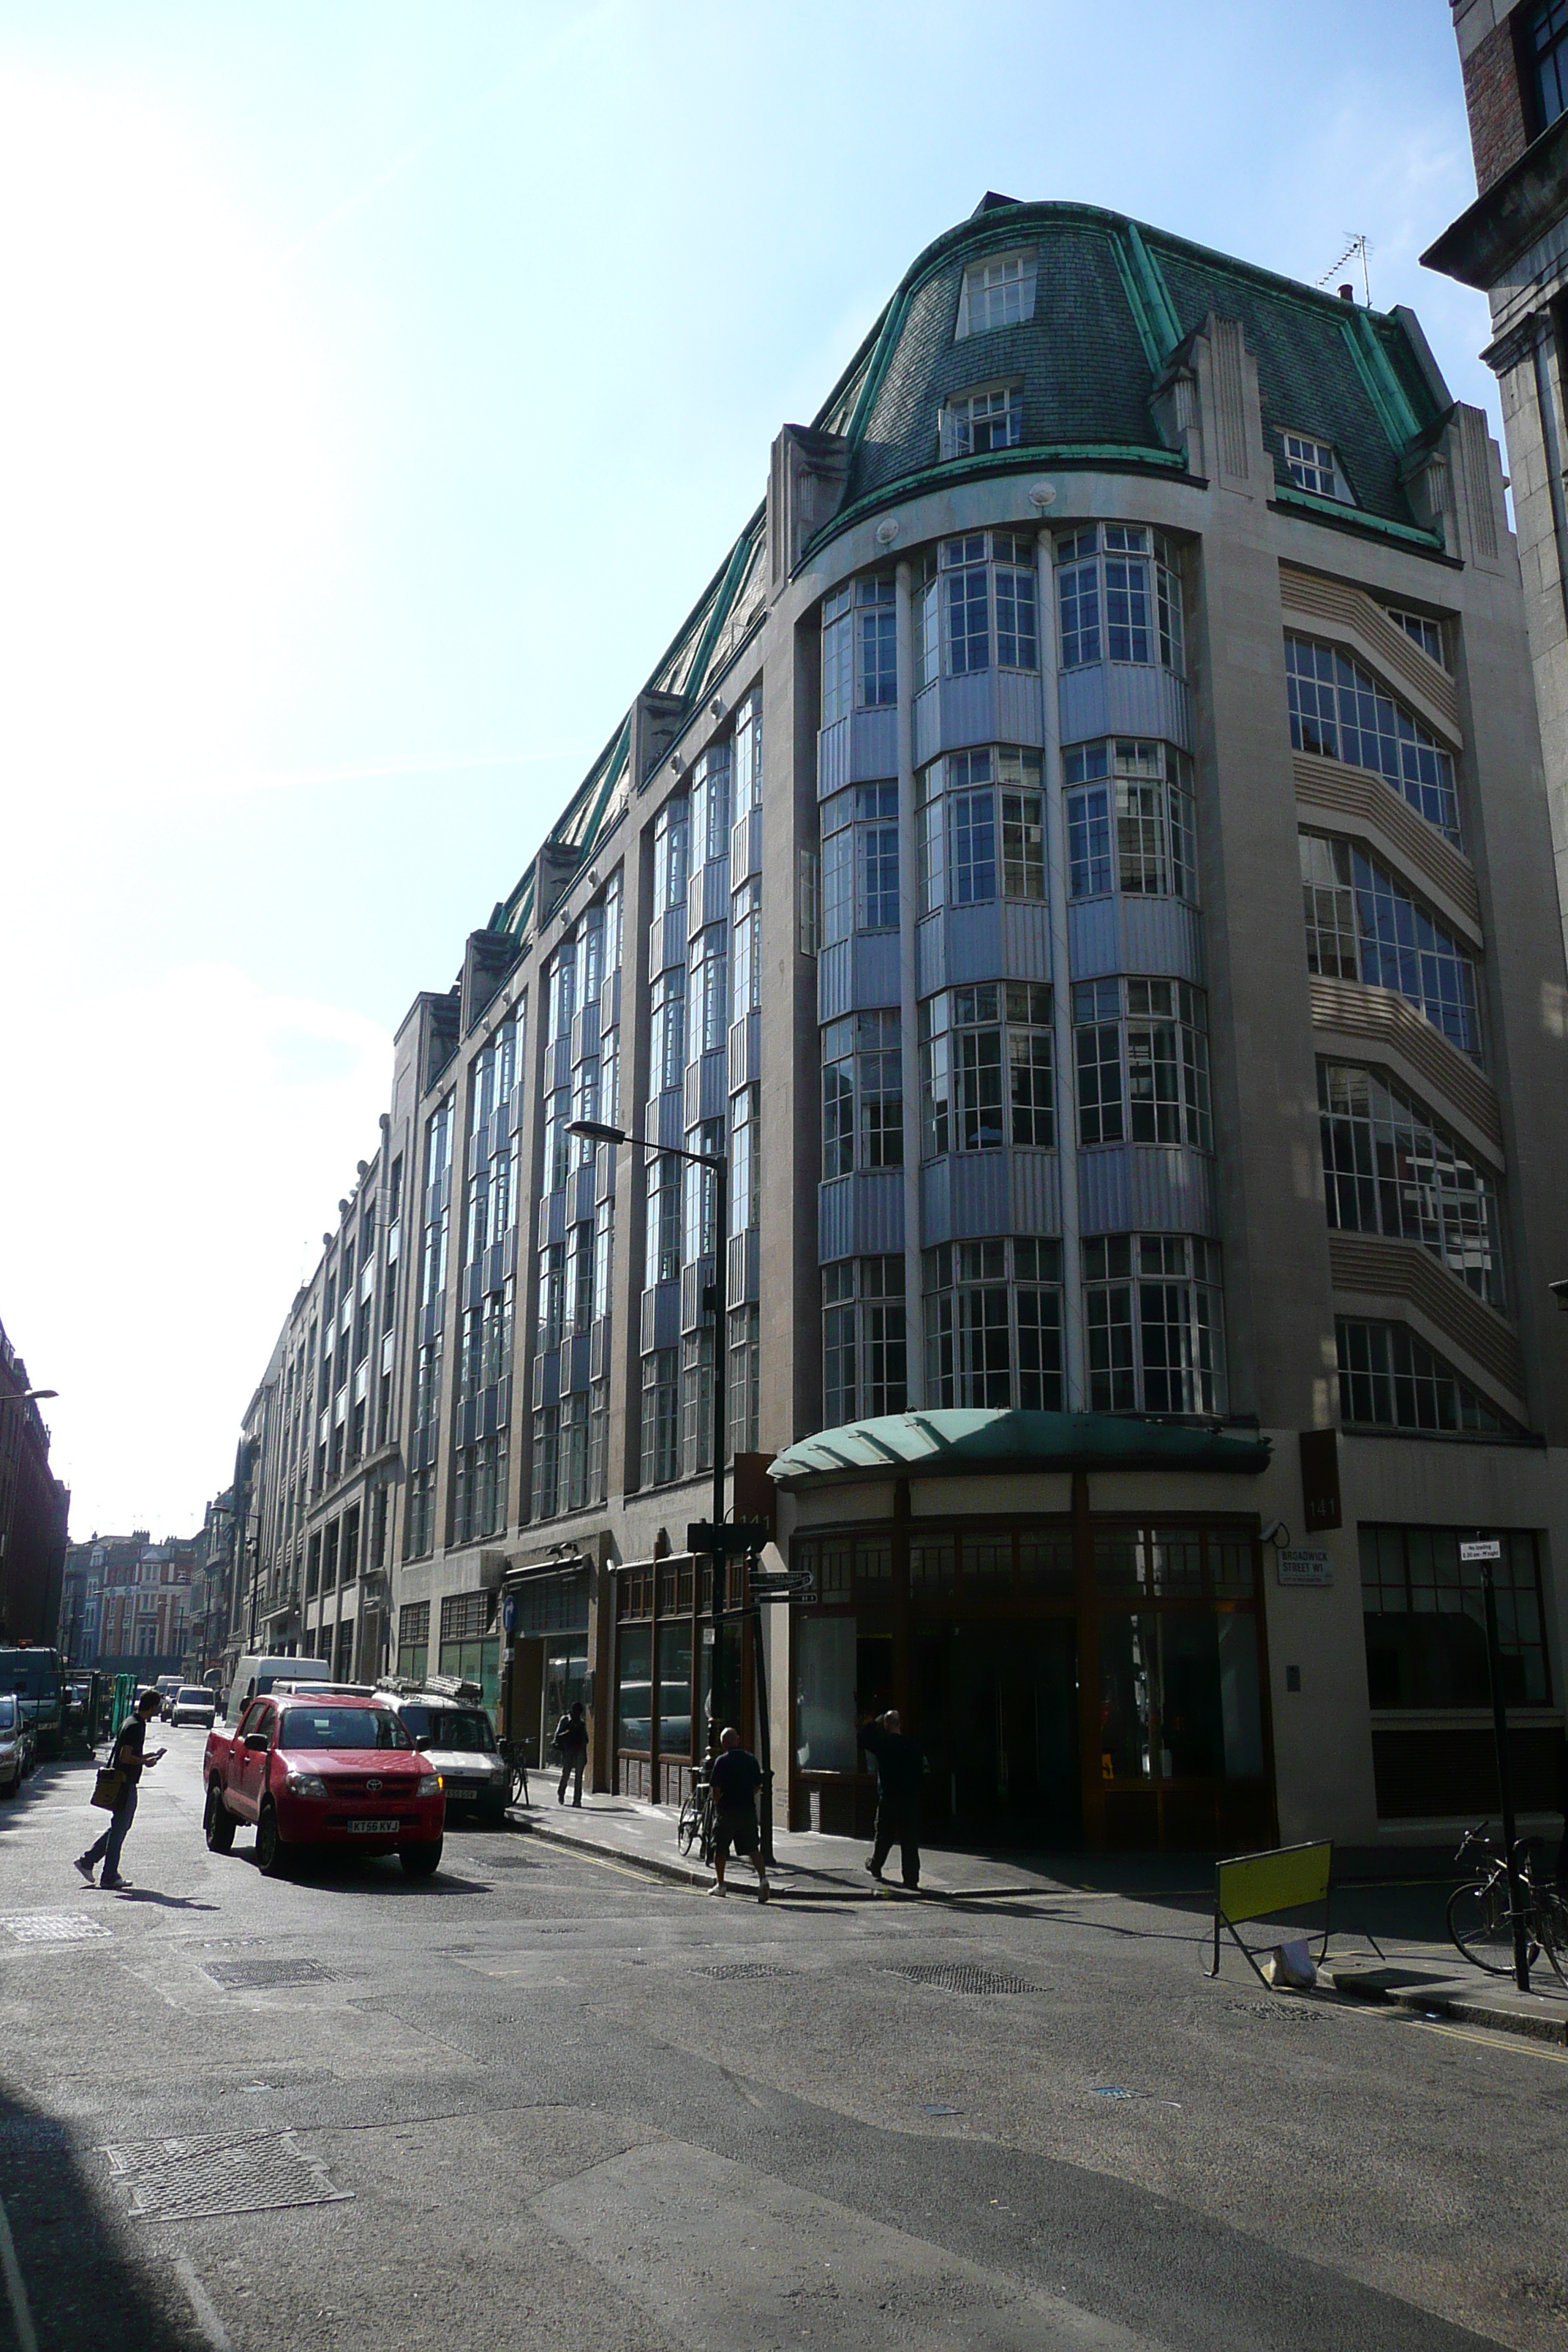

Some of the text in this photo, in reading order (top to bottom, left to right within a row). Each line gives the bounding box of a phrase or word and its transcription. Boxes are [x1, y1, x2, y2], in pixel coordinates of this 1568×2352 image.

[1308, 1498, 1335, 1517] 141
[1281, 1550, 1328, 1561] BROADWICK
[1283, 1562, 1323, 1572] STREET W1
[354, 1822, 398, 1831] KT56 KVJ
